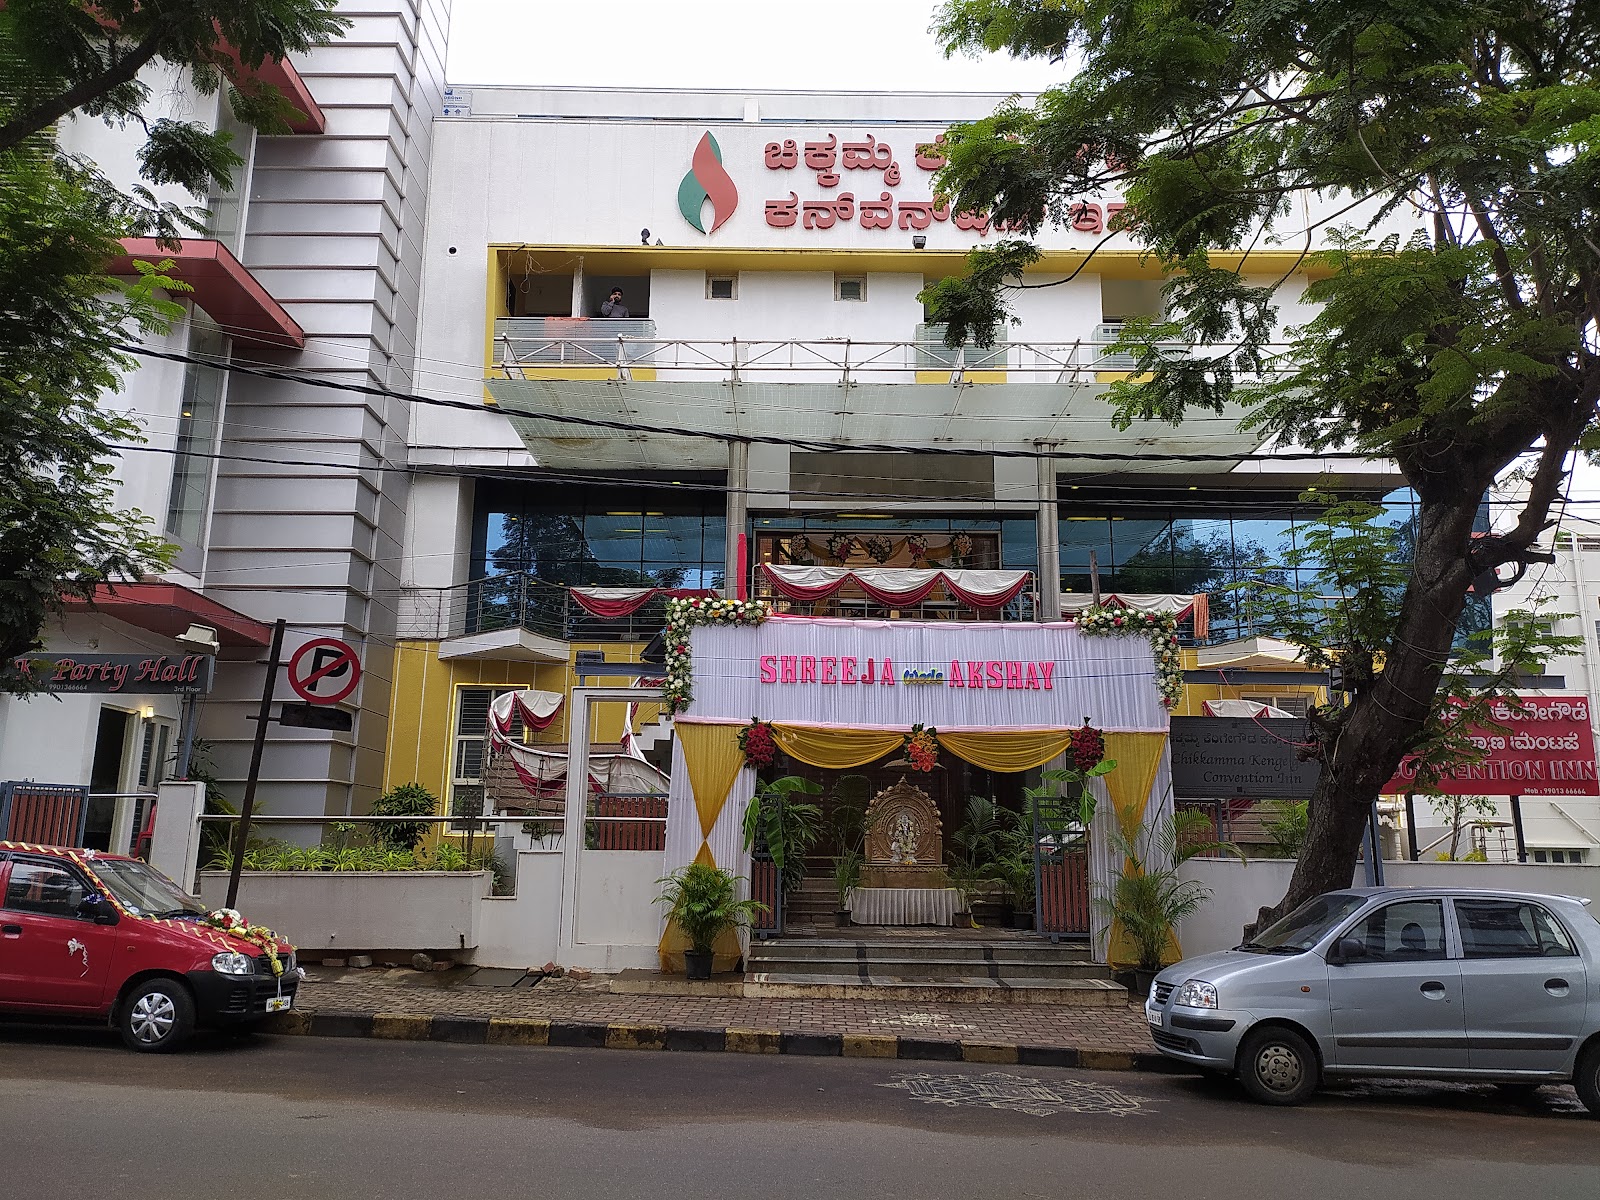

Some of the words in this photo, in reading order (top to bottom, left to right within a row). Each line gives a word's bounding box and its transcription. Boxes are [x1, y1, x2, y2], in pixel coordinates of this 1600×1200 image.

[764, 133, 902, 187] ಚಿಕ್ಕಮ್ಮ
[50, 658, 130, 692] Party
[134, 655, 205, 682] Hall
[760, 655, 895, 685] SHREEJA
[949, 660, 1056, 689] AKSHAY
[185, 685, 202, 693] Floor
[1171, 750, 1246, 765] Chikkamma
[1203, 770, 1273, 784] Convention
[1277, 772, 1303, 784] Inn
[1552, 758, 1598, 781] INN
[1543, 787, 1565, 795] 99013
[1566, 787, 1586, 795] 66664
